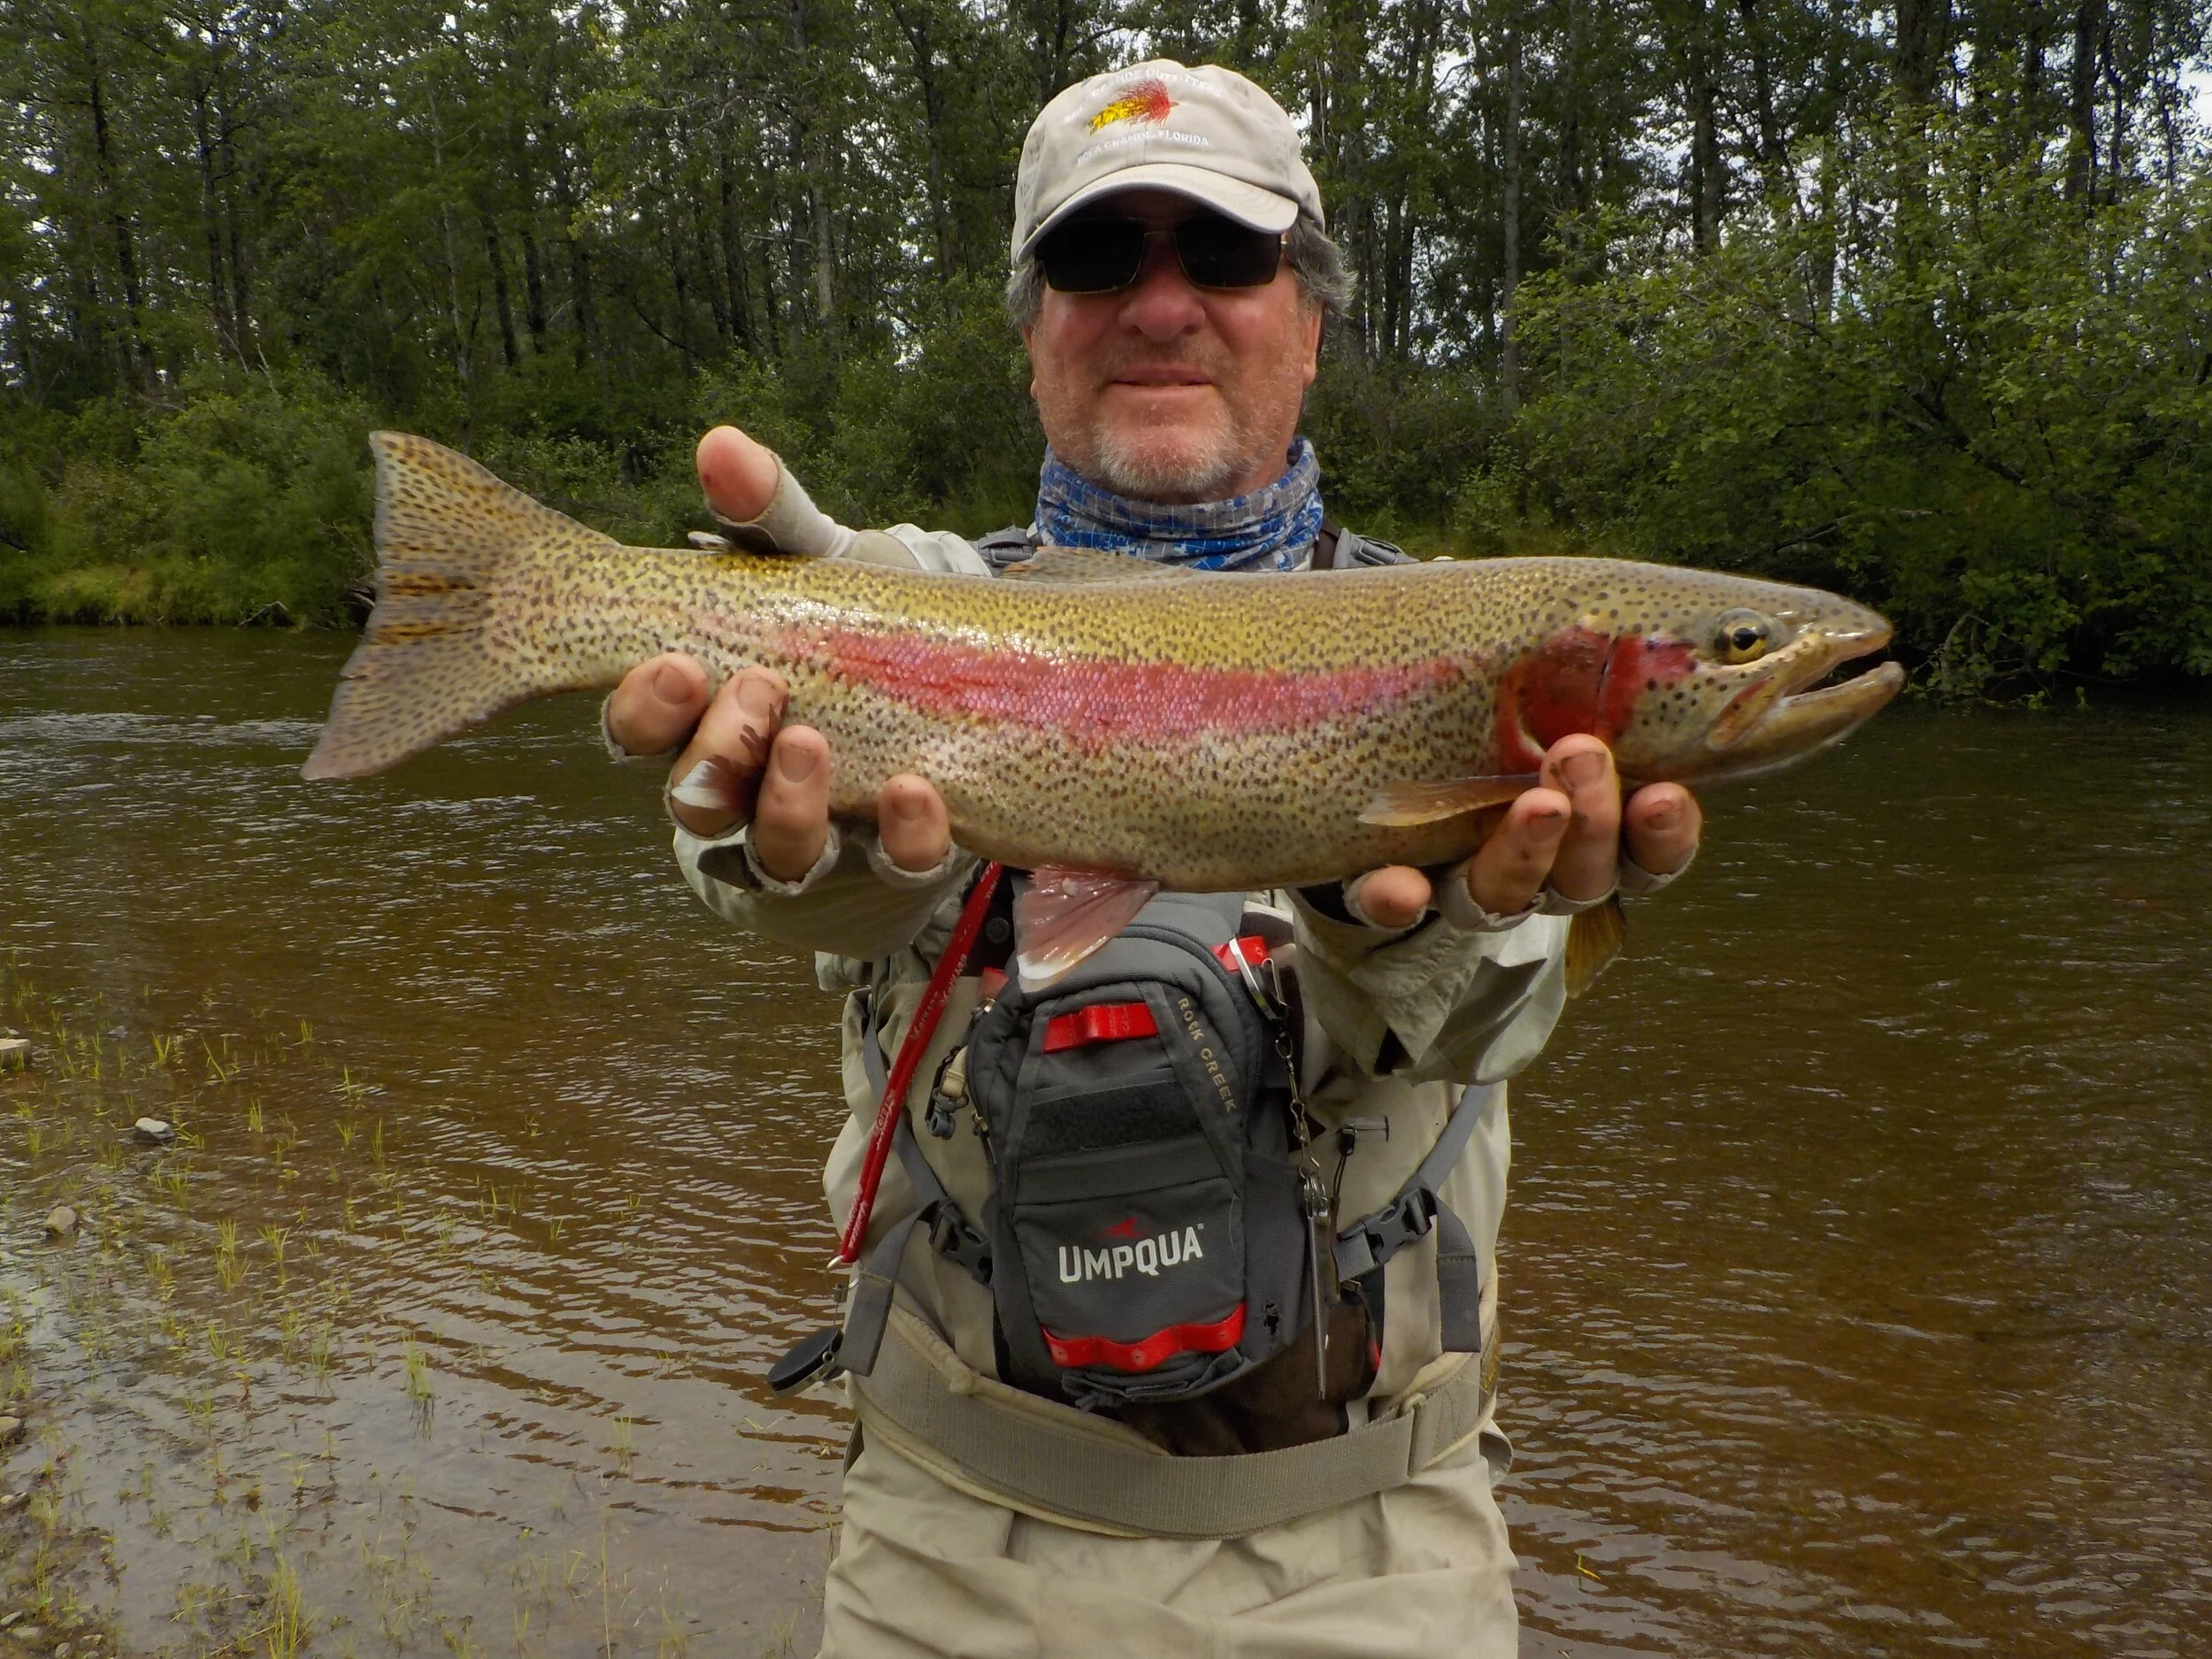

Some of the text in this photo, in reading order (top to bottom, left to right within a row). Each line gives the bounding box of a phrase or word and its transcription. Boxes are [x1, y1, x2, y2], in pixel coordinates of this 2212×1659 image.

[1158, 129, 1210, 147] FLORIDA
[1178, 997, 1236, 1112] ROCK CREEK
[1058, 1225, 1203, 1283] UMPQUA
